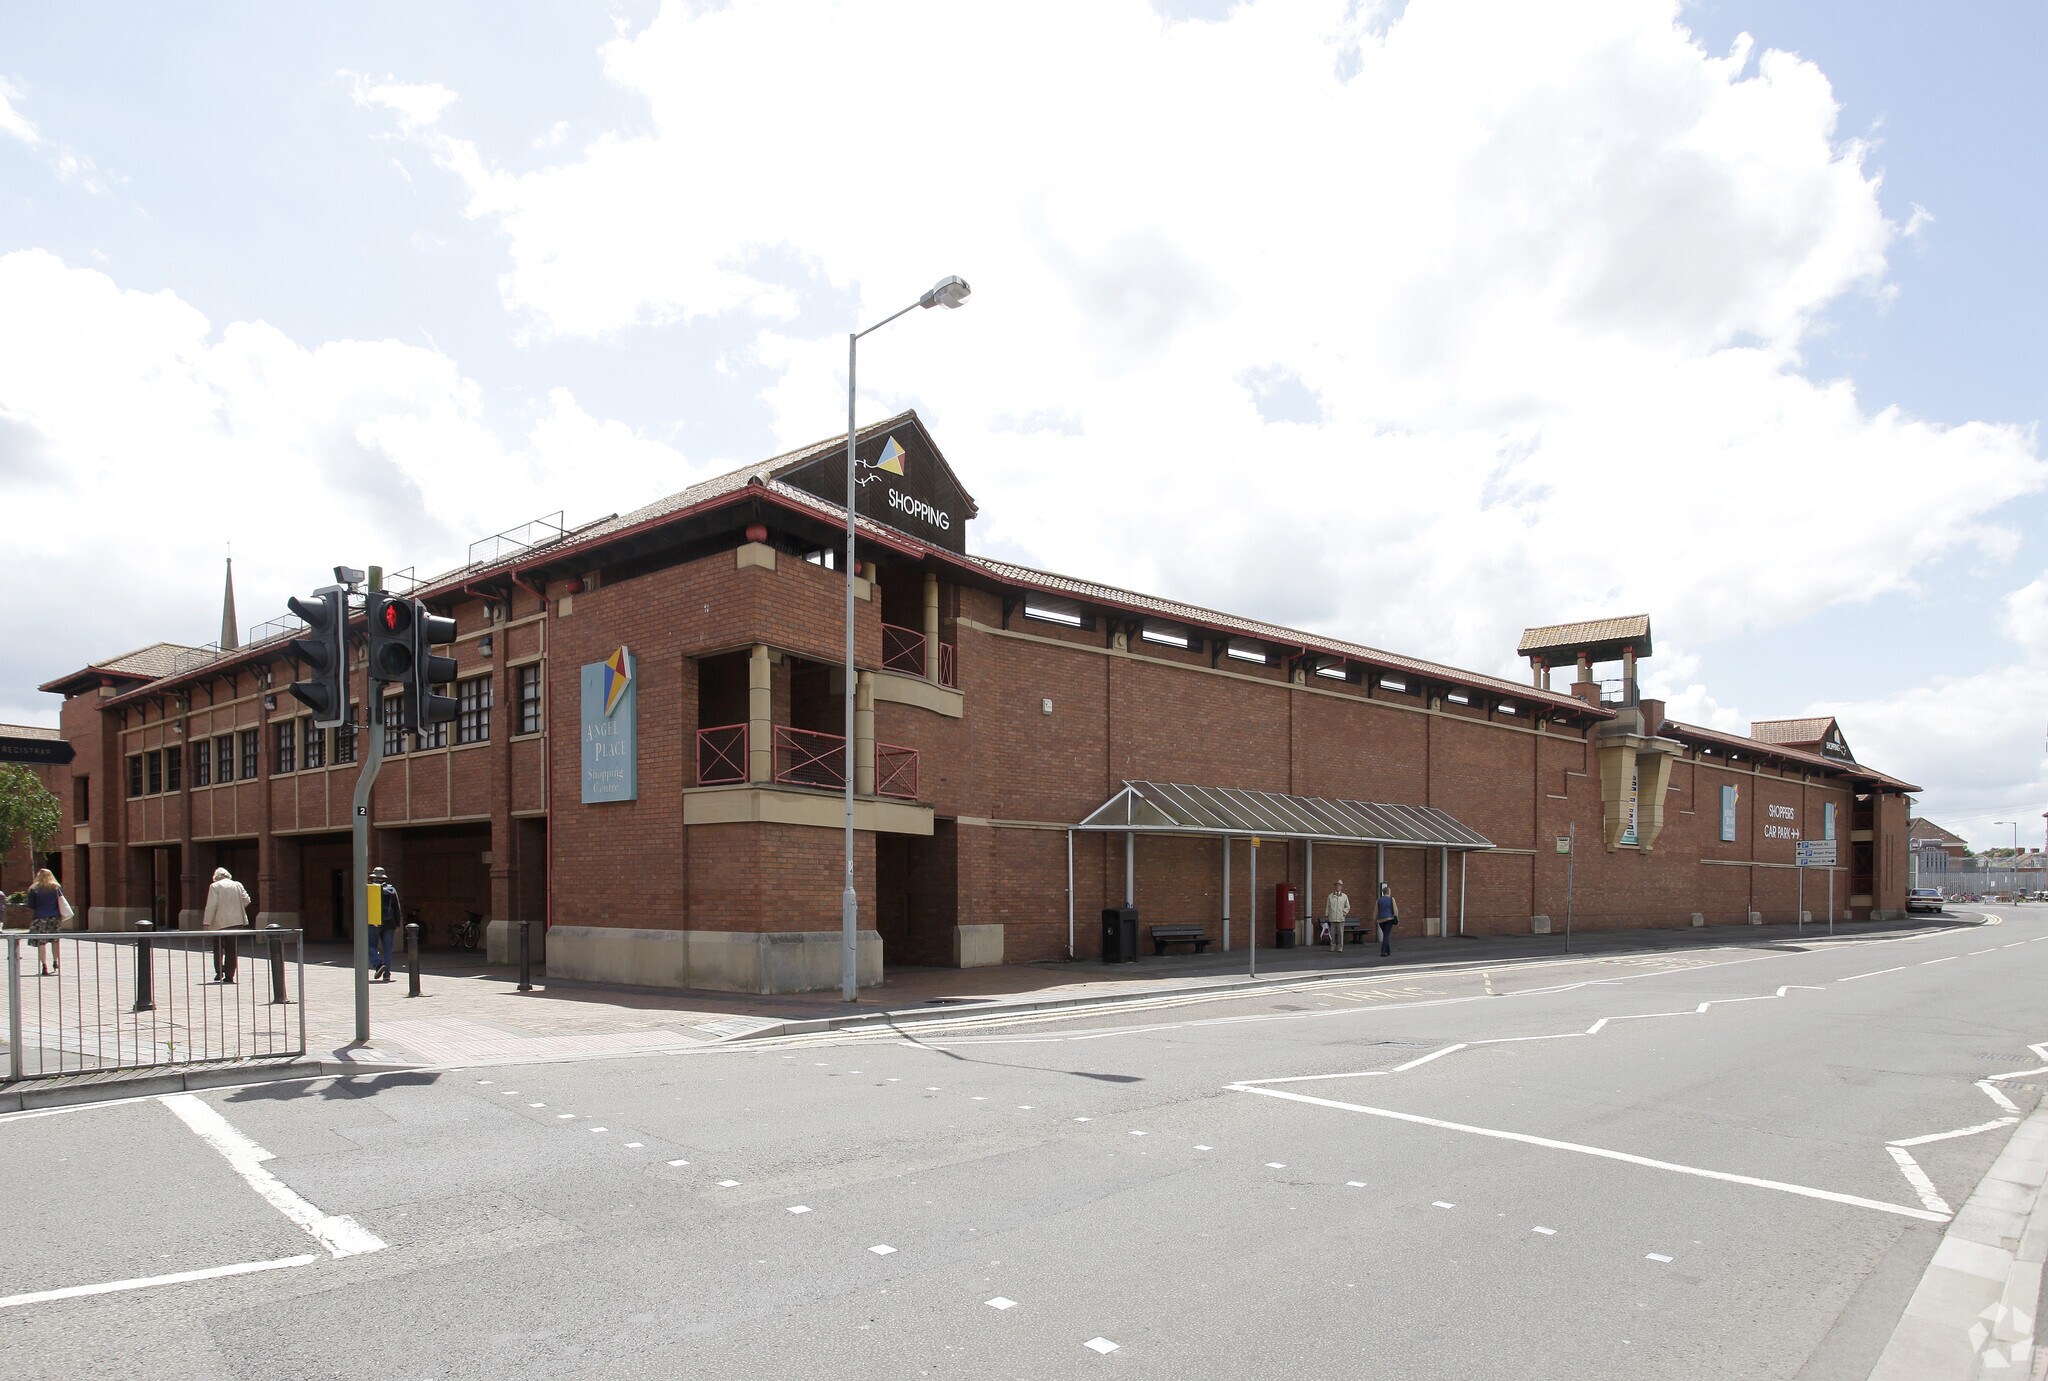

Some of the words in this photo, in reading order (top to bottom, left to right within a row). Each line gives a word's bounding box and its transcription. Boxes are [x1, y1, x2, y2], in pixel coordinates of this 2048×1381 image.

[888, 488, 950, 531] SHOPPING
[585, 720, 619, 742] ANGEL
[595, 740, 626, 762] PLACE
[588, 766, 624, 782] Shopping
[593, 782, 619, 794] Centre
[360, 807, 366, 815] 2
[1768, 804, 1795, 820] SHOPPERS
[1764, 824, 1777, 839] CAR
[1777, 826, 1791, 840] PARK
